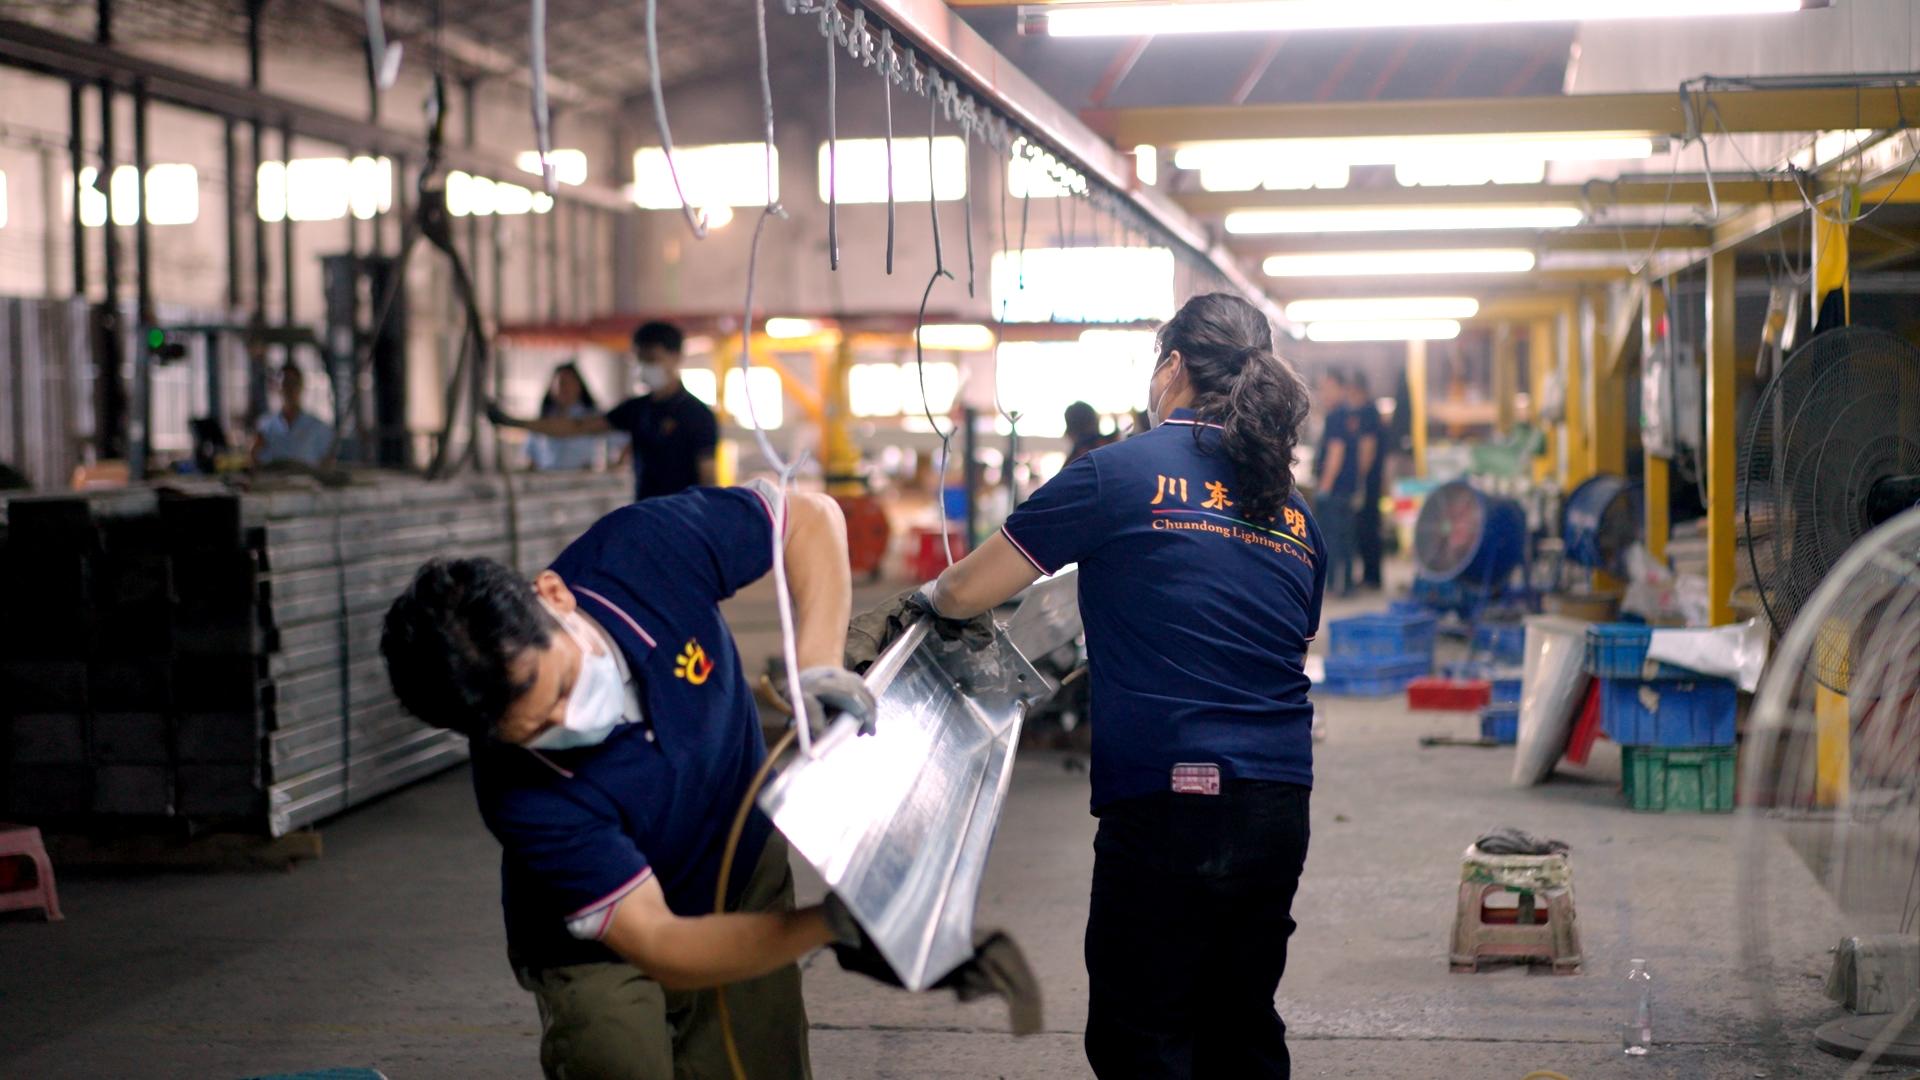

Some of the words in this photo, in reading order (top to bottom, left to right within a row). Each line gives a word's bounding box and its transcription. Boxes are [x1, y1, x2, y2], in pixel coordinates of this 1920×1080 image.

[1151, 474, 1307, 539] 川东明
[1152, 519, 1231, 538] Chuandong
[1233, 526, 1281, 553] Lighting
